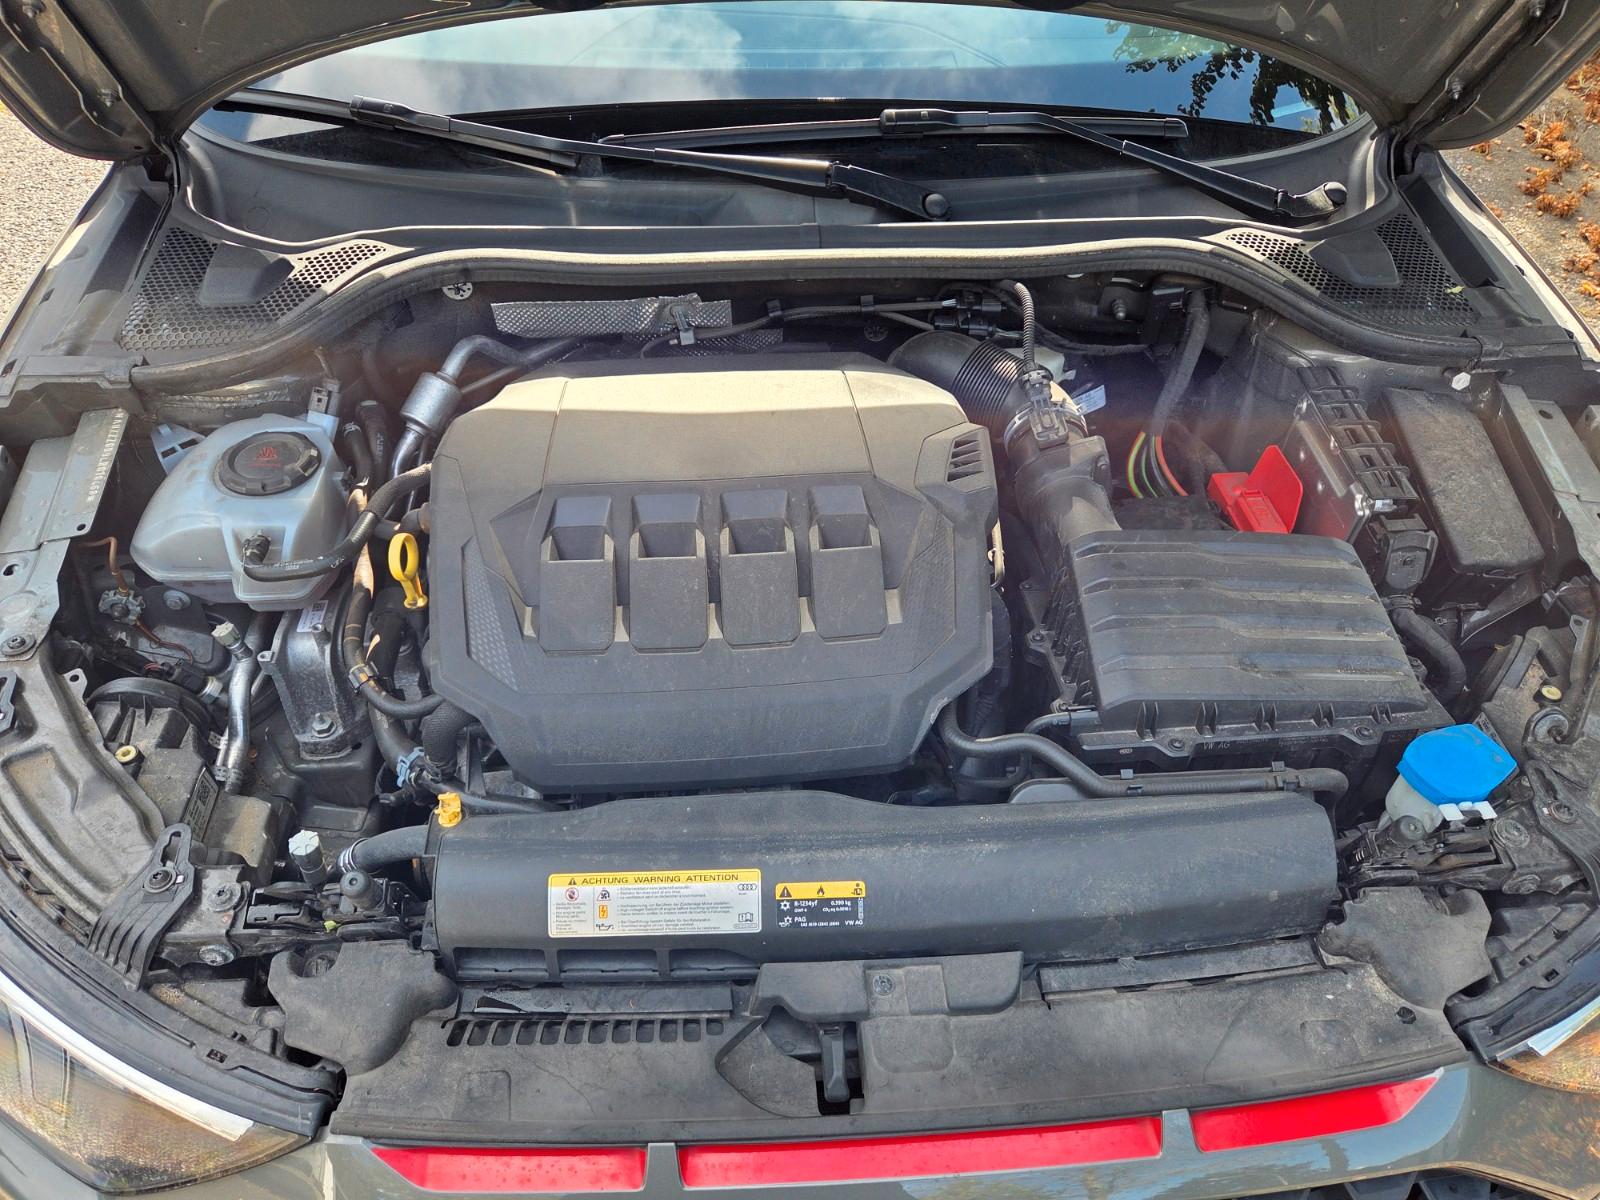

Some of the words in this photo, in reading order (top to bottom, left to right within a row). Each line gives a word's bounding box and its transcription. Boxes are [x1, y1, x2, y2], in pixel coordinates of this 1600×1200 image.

[582, 876, 628, 886] ACHTUNG
[634, 874, 681, 884] WARNING
[686, 873, 739, 882] ATTENTION
